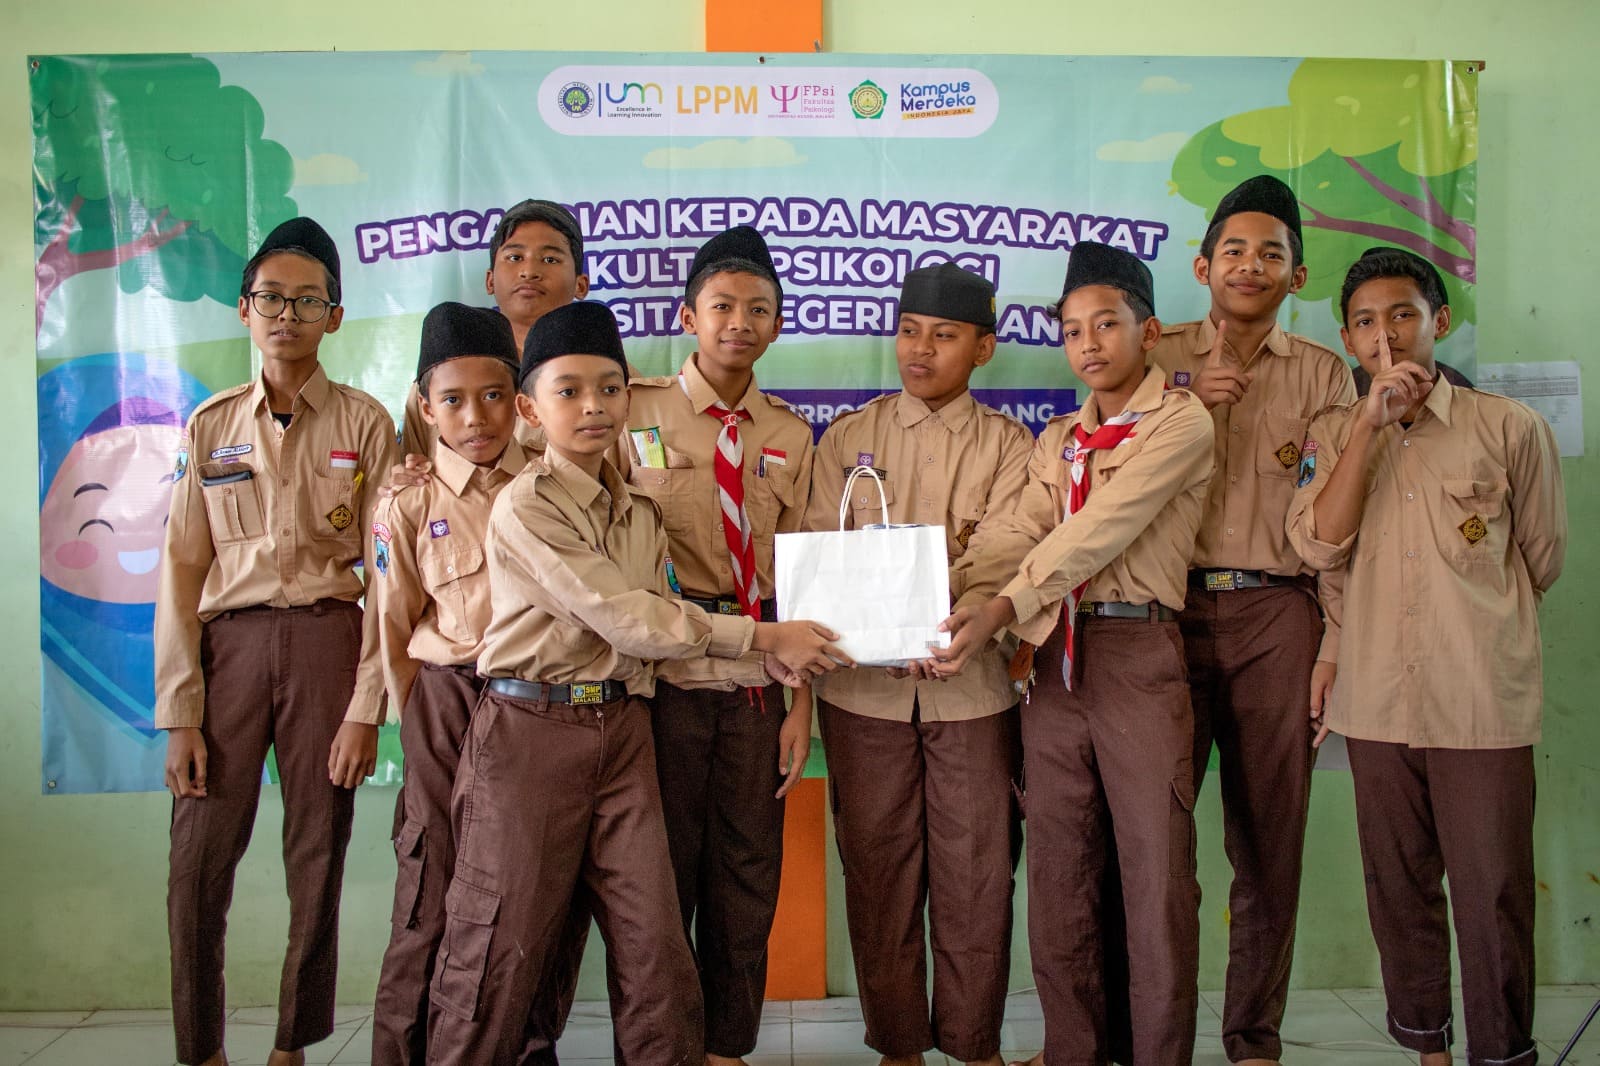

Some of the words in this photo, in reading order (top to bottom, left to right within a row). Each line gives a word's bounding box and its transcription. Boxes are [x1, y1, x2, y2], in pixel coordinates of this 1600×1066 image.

[677, 85, 758, 114] LPPM
[803, 85, 834, 96] FPsi
[901, 82, 970, 97] Kampus
[901, 94, 976, 112] Merdeka
[669, 202, 853, 234] KEPADA
[865, 204, 1164, 256] MASYARAKAT
[781, 300, 895, 331] EGERI
